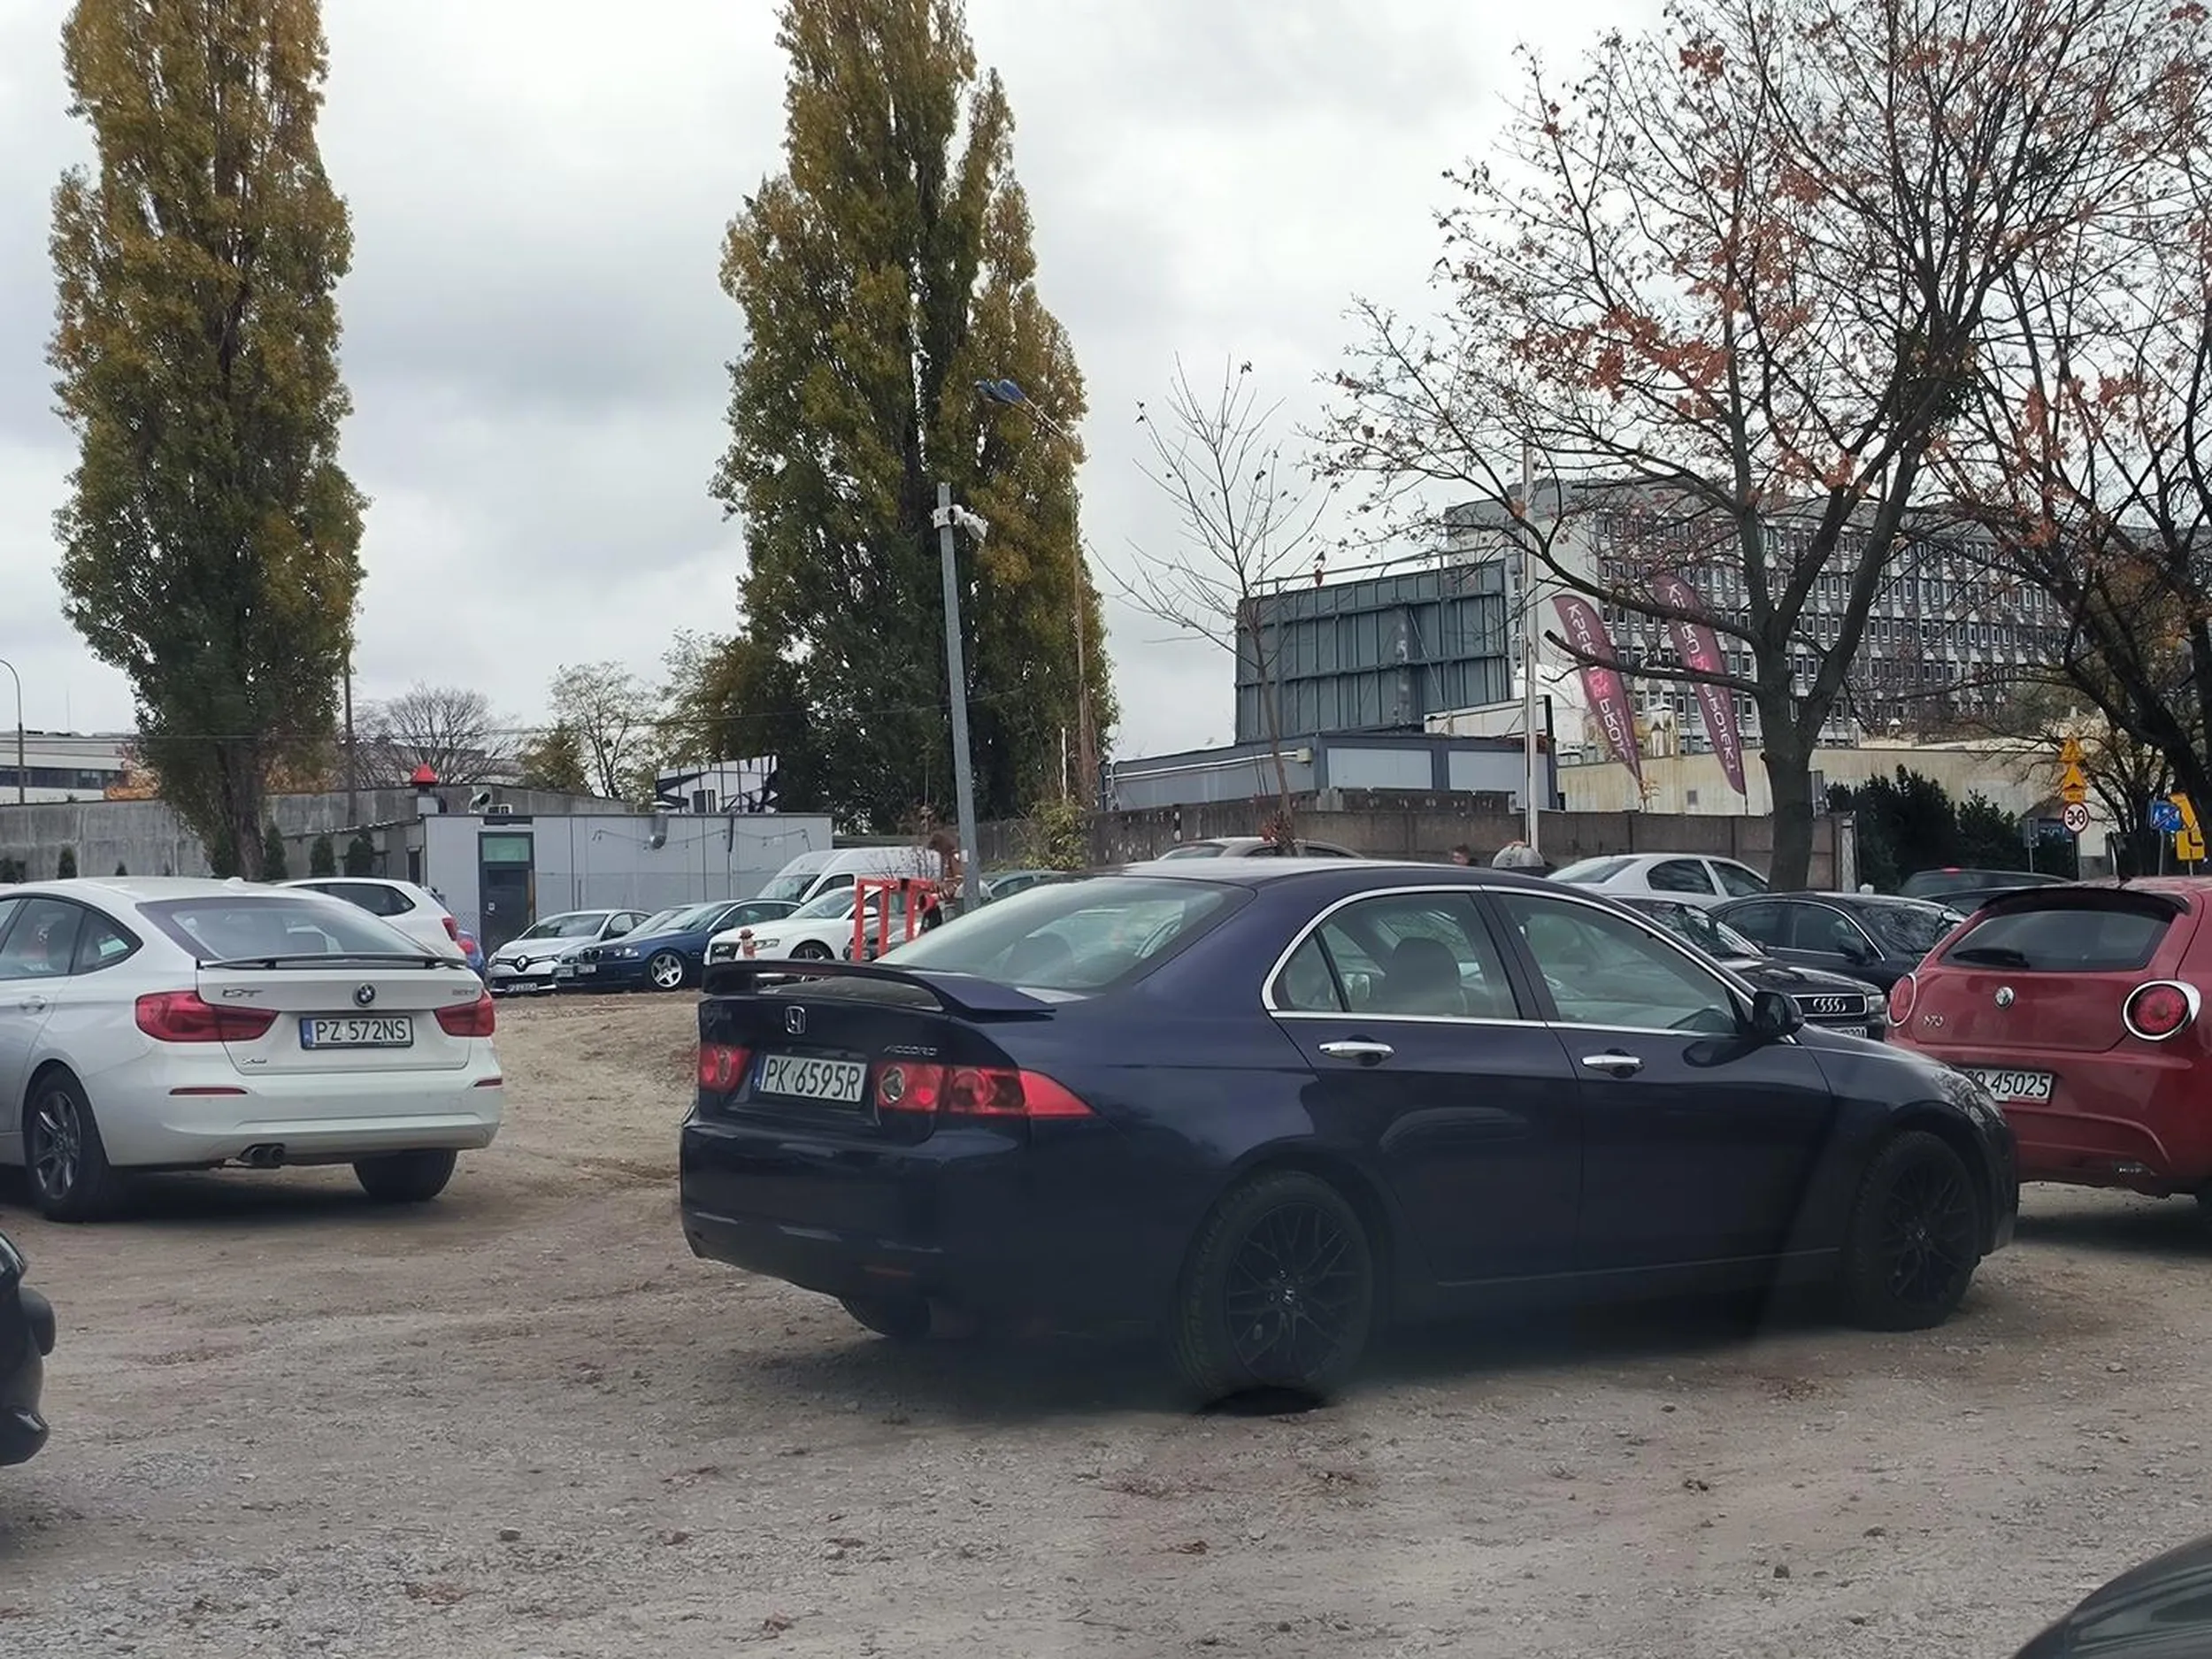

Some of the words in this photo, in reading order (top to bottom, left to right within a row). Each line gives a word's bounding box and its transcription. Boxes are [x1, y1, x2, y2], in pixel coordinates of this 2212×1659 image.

[2067, 809, 2085, 826] 30
[316, 1022, 341, 1041] PZ
[351, 1020, 407, 1041] 572NS
[763, 1058, 791, 1093] PK
[795, 1061, 862, 1100] 6595R
[1990, 1072, 2049, 1096] 45025
